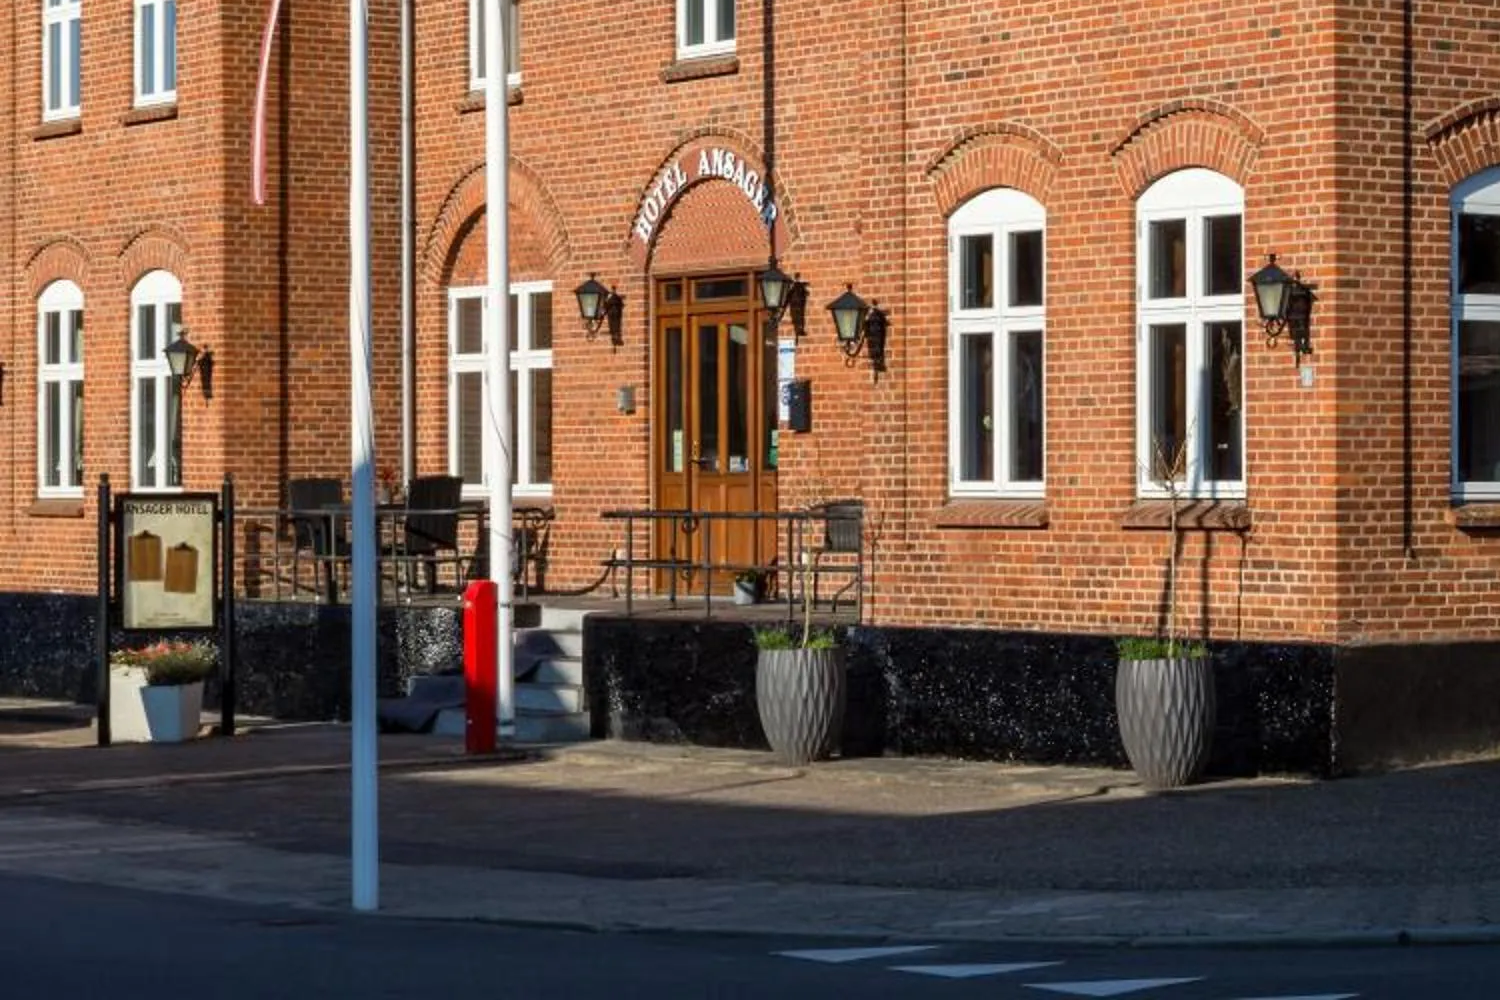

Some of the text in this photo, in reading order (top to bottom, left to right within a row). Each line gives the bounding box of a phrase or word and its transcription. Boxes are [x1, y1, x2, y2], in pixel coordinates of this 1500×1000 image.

[634, 148, 777, 243] HOTEL ANSAGER
[125, 503, 208, 514] ANSAGER HOTEL
